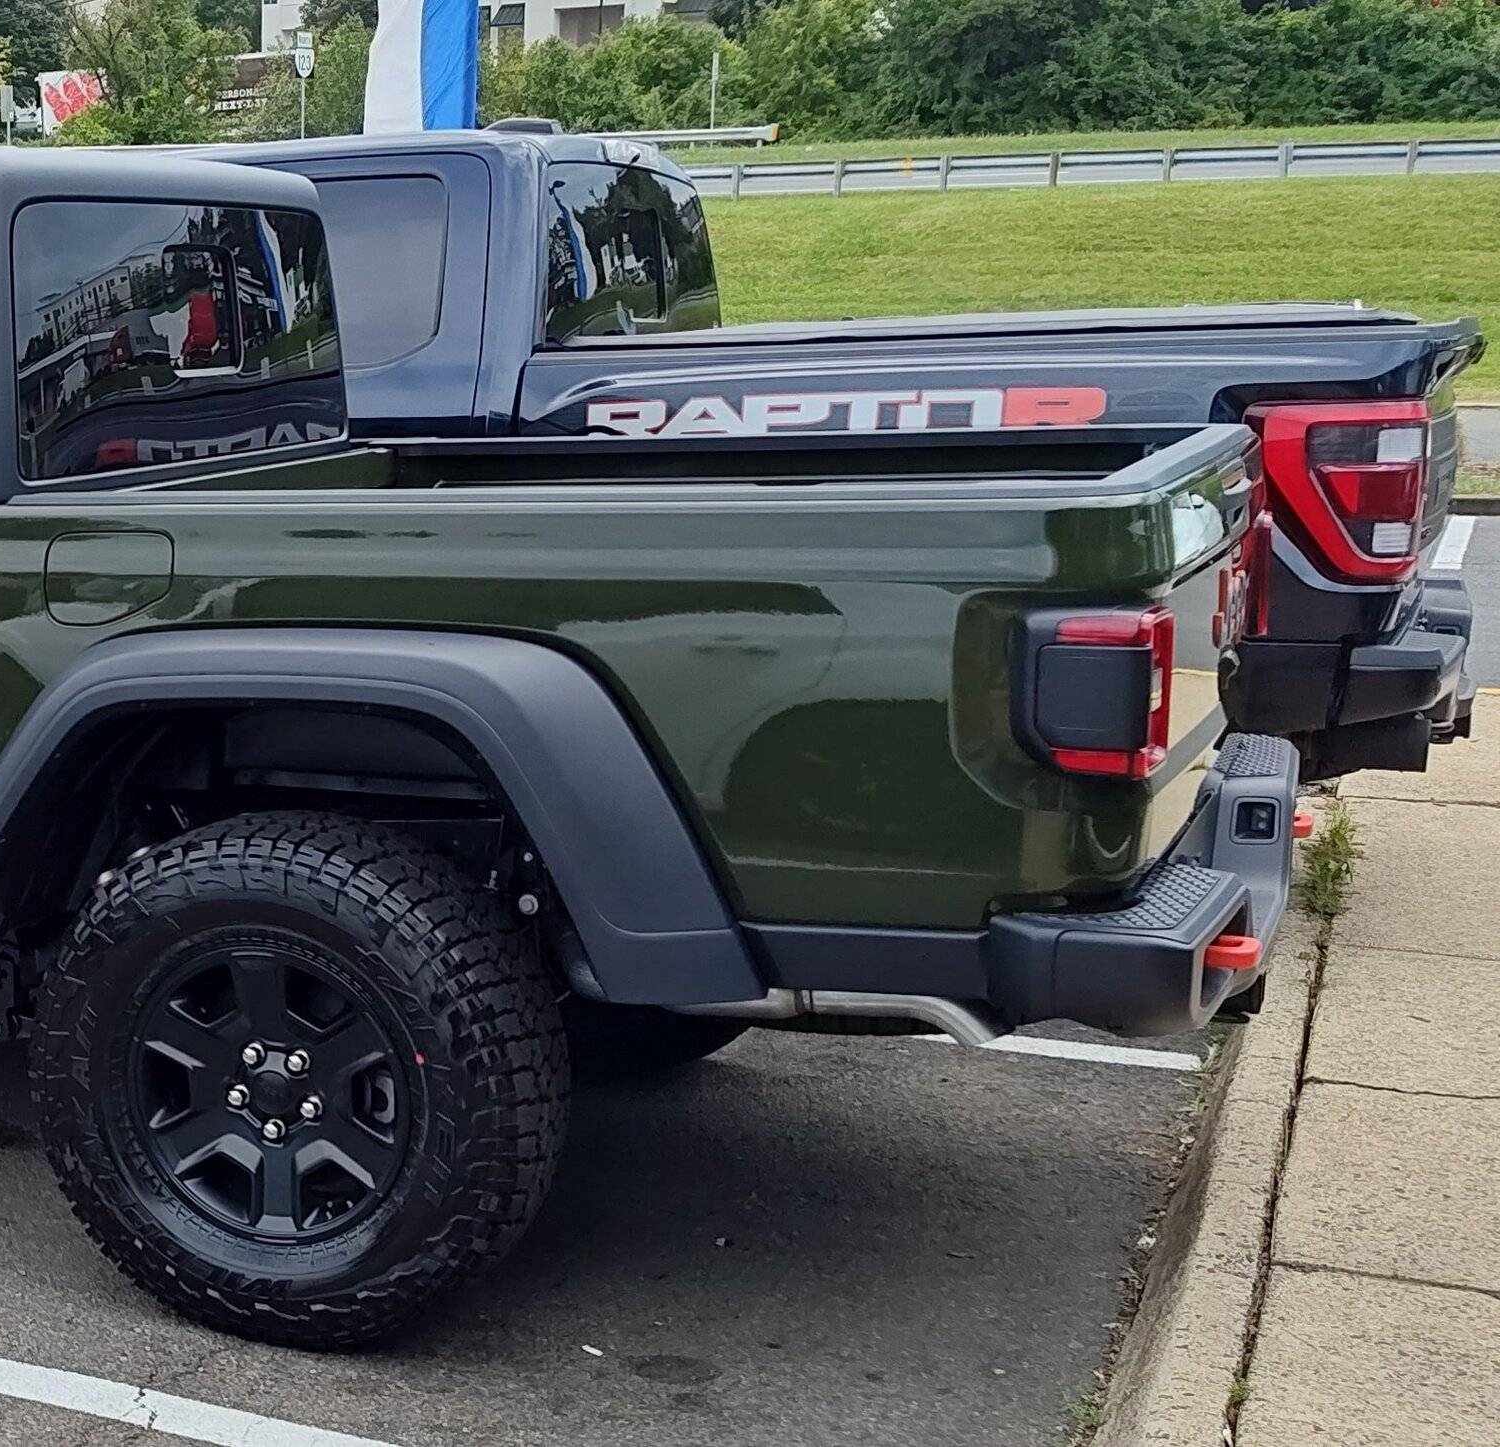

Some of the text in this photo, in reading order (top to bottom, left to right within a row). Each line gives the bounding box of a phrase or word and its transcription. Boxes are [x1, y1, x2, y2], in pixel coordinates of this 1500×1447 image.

[298, 54, 312, 71] 123
[215, 87, 260, 99] PERSONA
[588, 387, 1107, 437] RAPTOR
